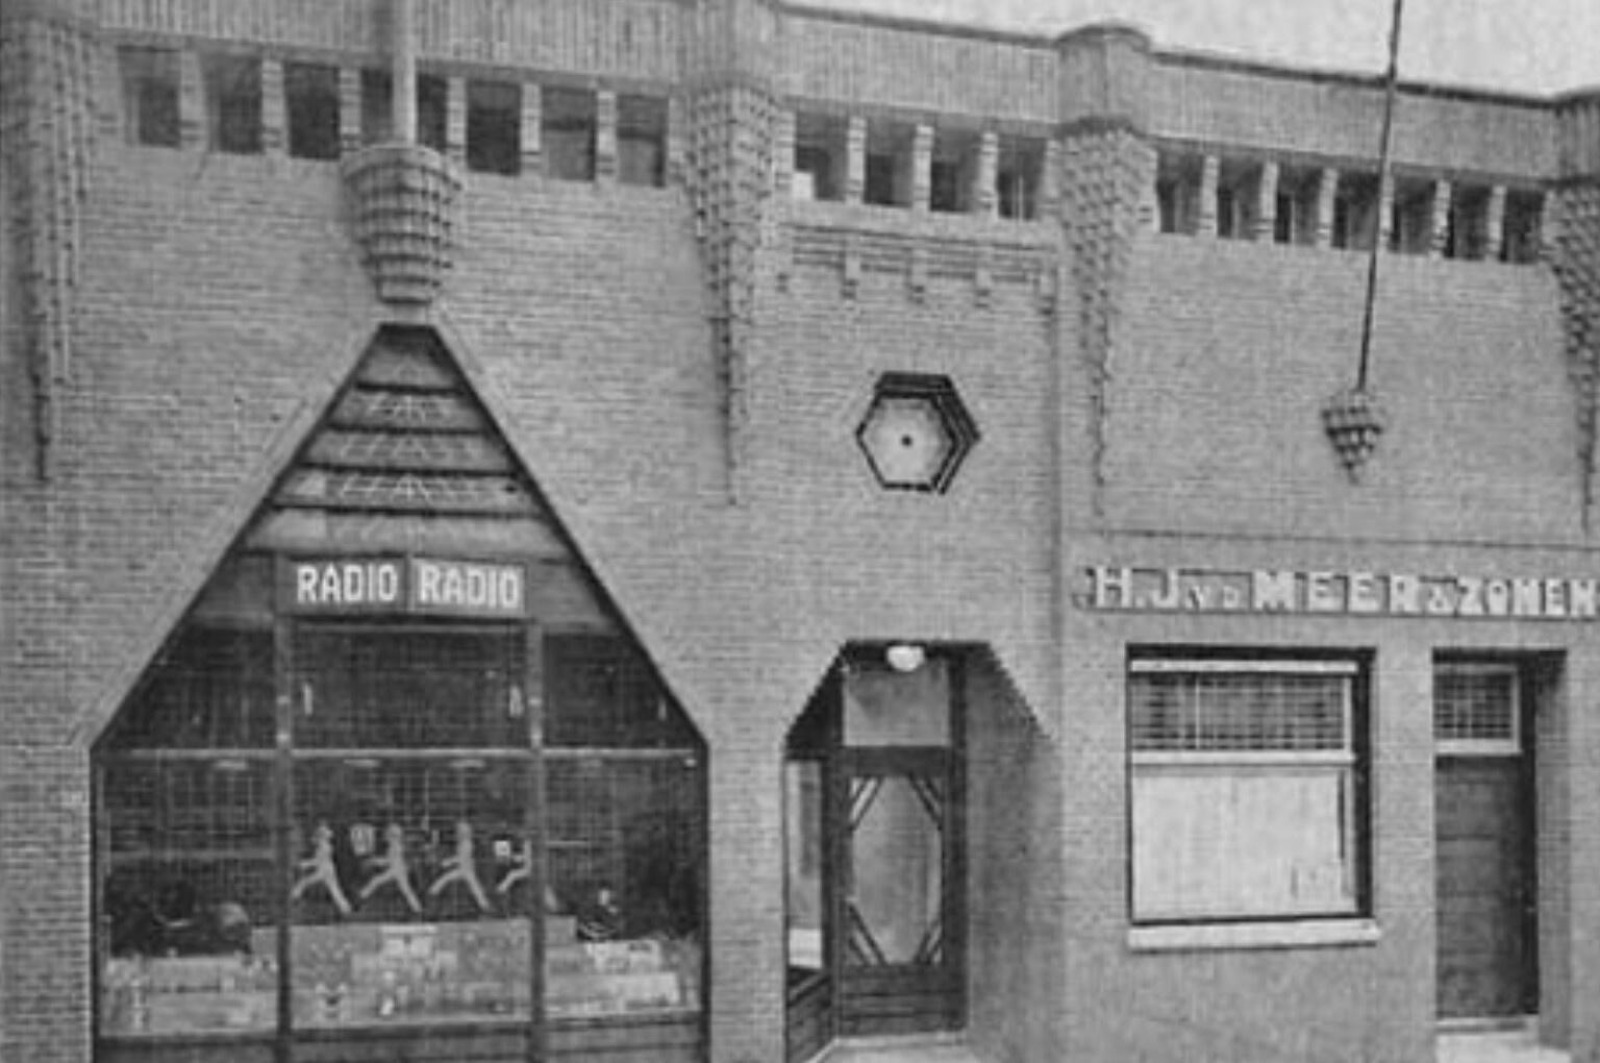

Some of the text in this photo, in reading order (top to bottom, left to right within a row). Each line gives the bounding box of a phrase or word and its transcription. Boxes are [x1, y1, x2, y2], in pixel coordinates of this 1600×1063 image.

[297, 562, 520, 610] RADIO RADIO
[1254, 570, 1420, 614] MEER
